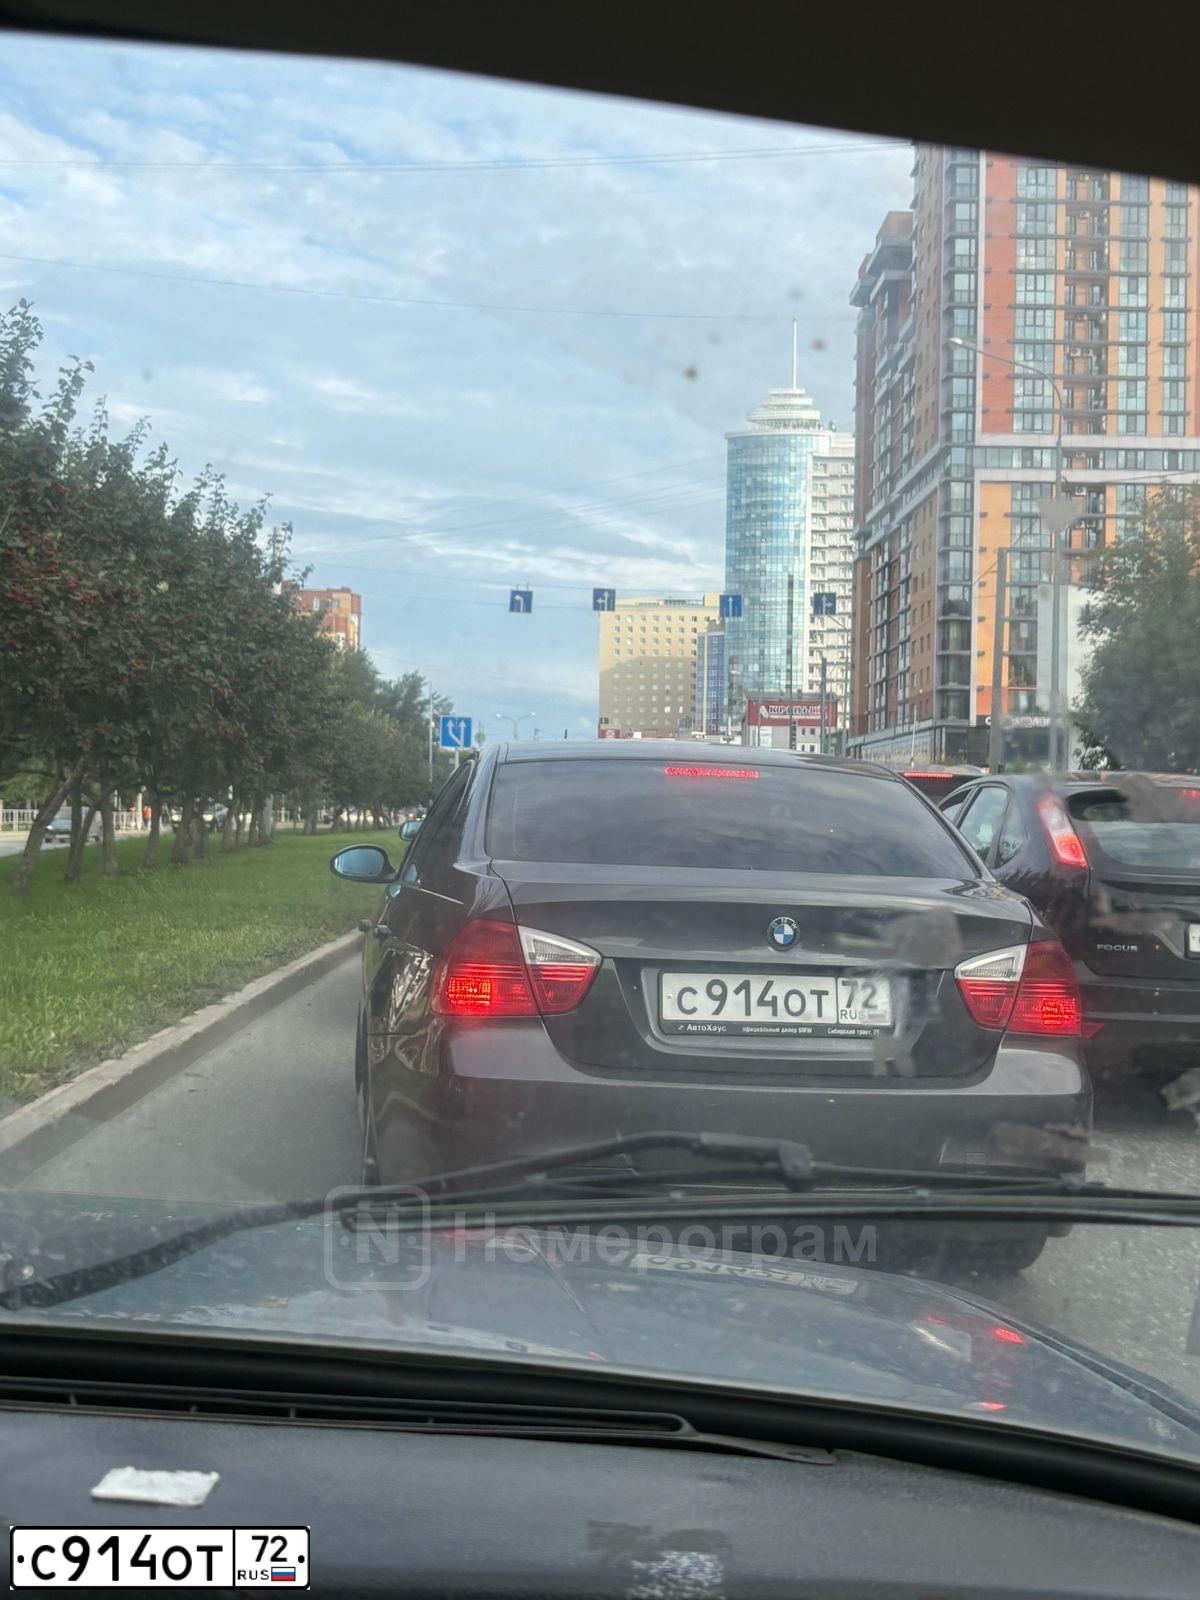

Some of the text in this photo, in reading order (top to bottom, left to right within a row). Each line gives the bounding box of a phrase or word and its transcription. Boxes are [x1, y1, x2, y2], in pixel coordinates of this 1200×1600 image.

[1096, 943, 1139, 952] FOCUS
[676, 978, 879, 1018] С914ОТ 72
[686, 1023, 727, 1032] АвтоХаус
